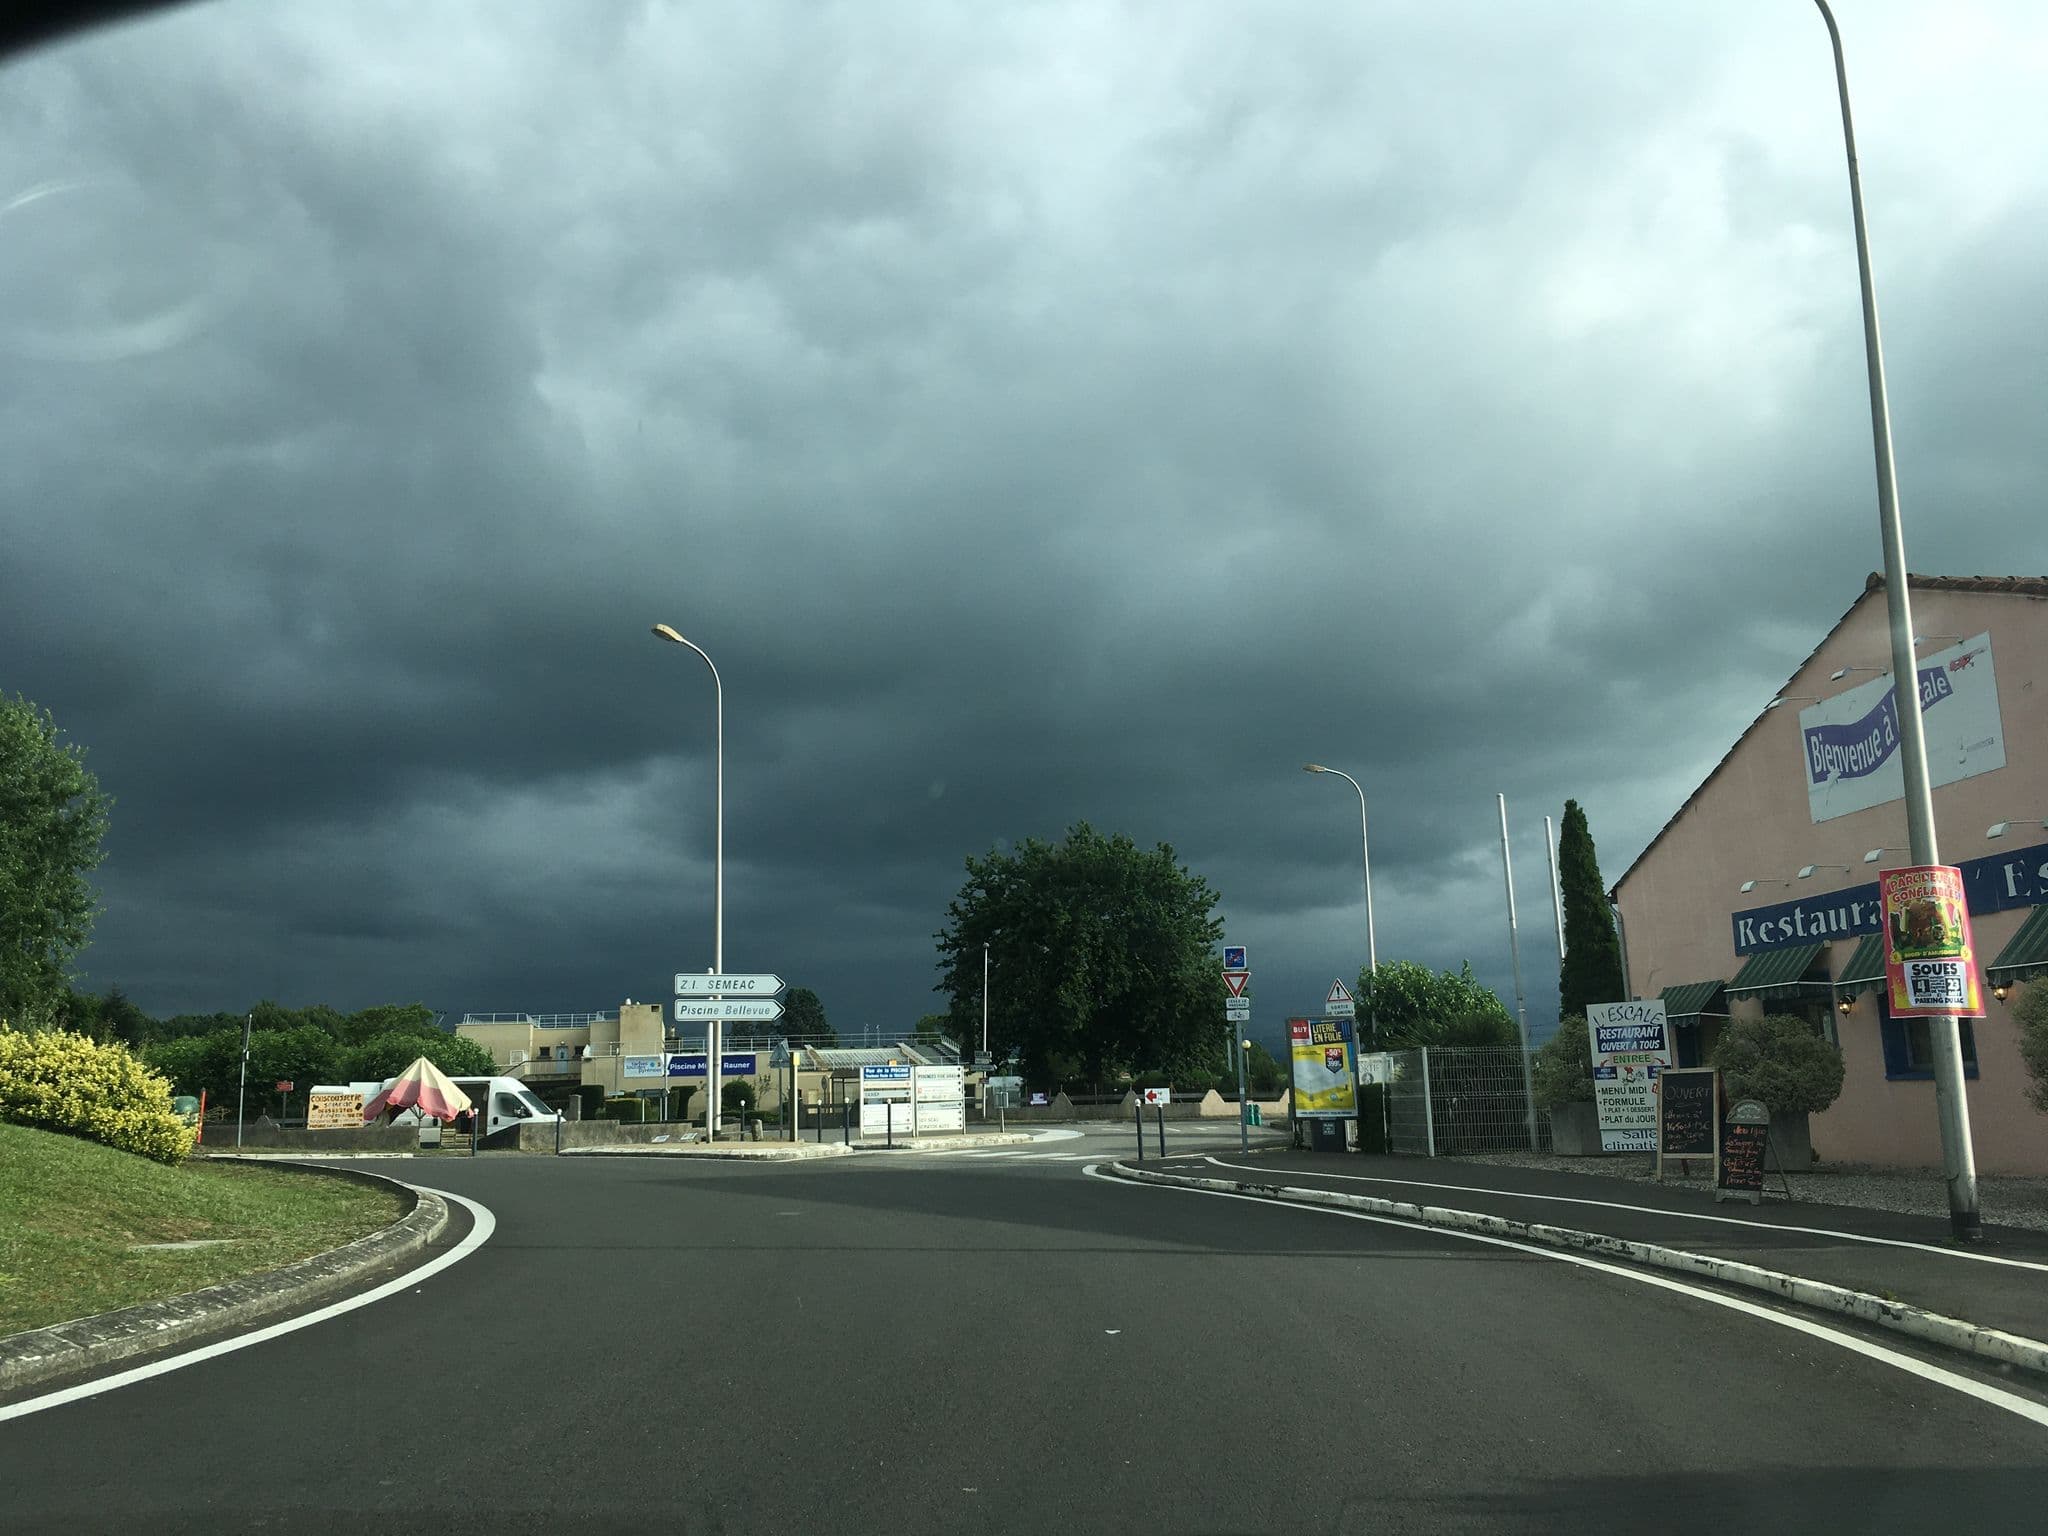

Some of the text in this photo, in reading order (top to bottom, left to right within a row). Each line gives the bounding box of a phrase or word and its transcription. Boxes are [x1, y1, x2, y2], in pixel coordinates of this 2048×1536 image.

[1810, 727, 1882, 774] Bienvenue
[1882, 705, 1895, 746] à
[1738, 899, 1883, 948] Restaura
[1911, 963, 1958, 976] SOUES
[707, 980, 756, 990] SEMEAC
[1947, 979, 1960, 991] 23
[680, 1005, 771, 1015] Piscine Bellevue
[1592, 1005, 1664, 1027] L'ESCALE
[1312, 1022, 1337, 1034] LITERIE
[1599, 1026, 1660, 1040] RESTAURANT
[1314, 1031, 1343, 1042] EN FOLIE
[1600, 1040, 1660, 1051] OUVERT A TOUS
[669, 1062, 697, 1070] Piscine
[1601, 1086, 1647, 1095] MENU MIDI
[1603, 1097, 1646, 1106] FORMULE
[1604, 1116, 1623, 1124] PLAT
[1635, 1115, 1657, 1123] JOUR
[1622, 1129, 1657, 1139] Salle
[1604, 1141, 1658, 1150] climatis
